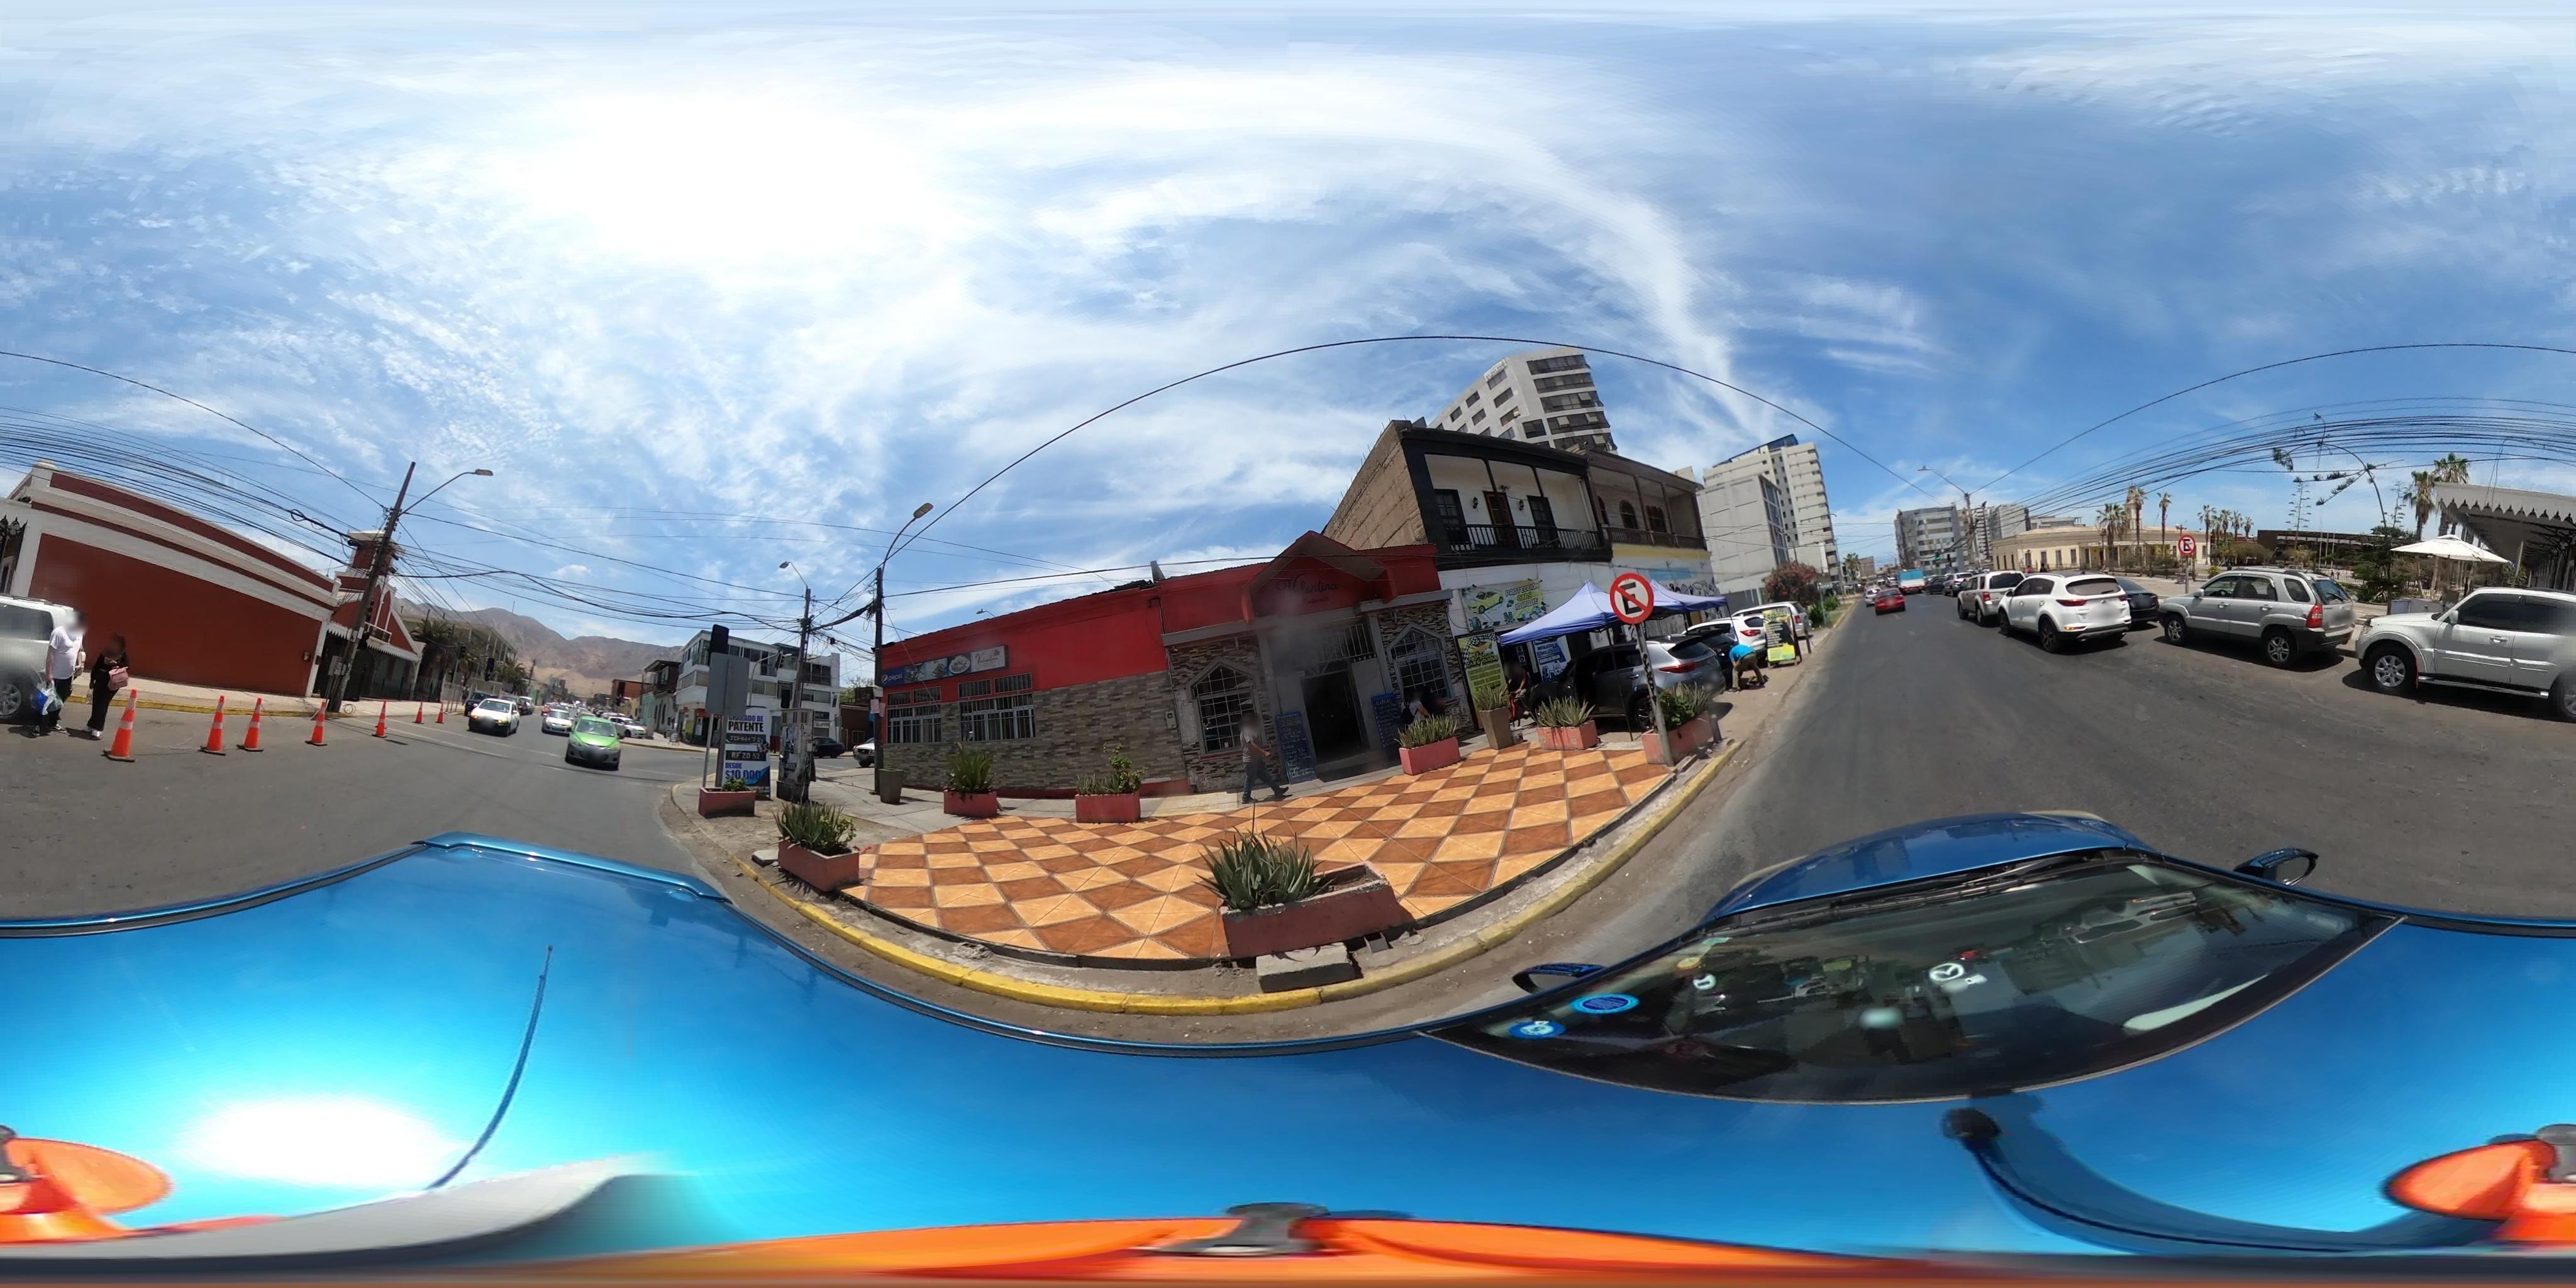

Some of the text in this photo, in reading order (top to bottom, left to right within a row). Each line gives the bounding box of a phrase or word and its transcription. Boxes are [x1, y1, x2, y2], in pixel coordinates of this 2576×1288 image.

[2183, 538, 2190, 552] E
[1518, 591, 1532, 601] CARS
[1619, 582, 1642, 615] E
[1515, 598, 1538, 610] IQUIQUE
[888, 672, 903, 682] pepsi
[728, 721, 764, 732] PATENTE
[725, 770, 760, 780] $10000
